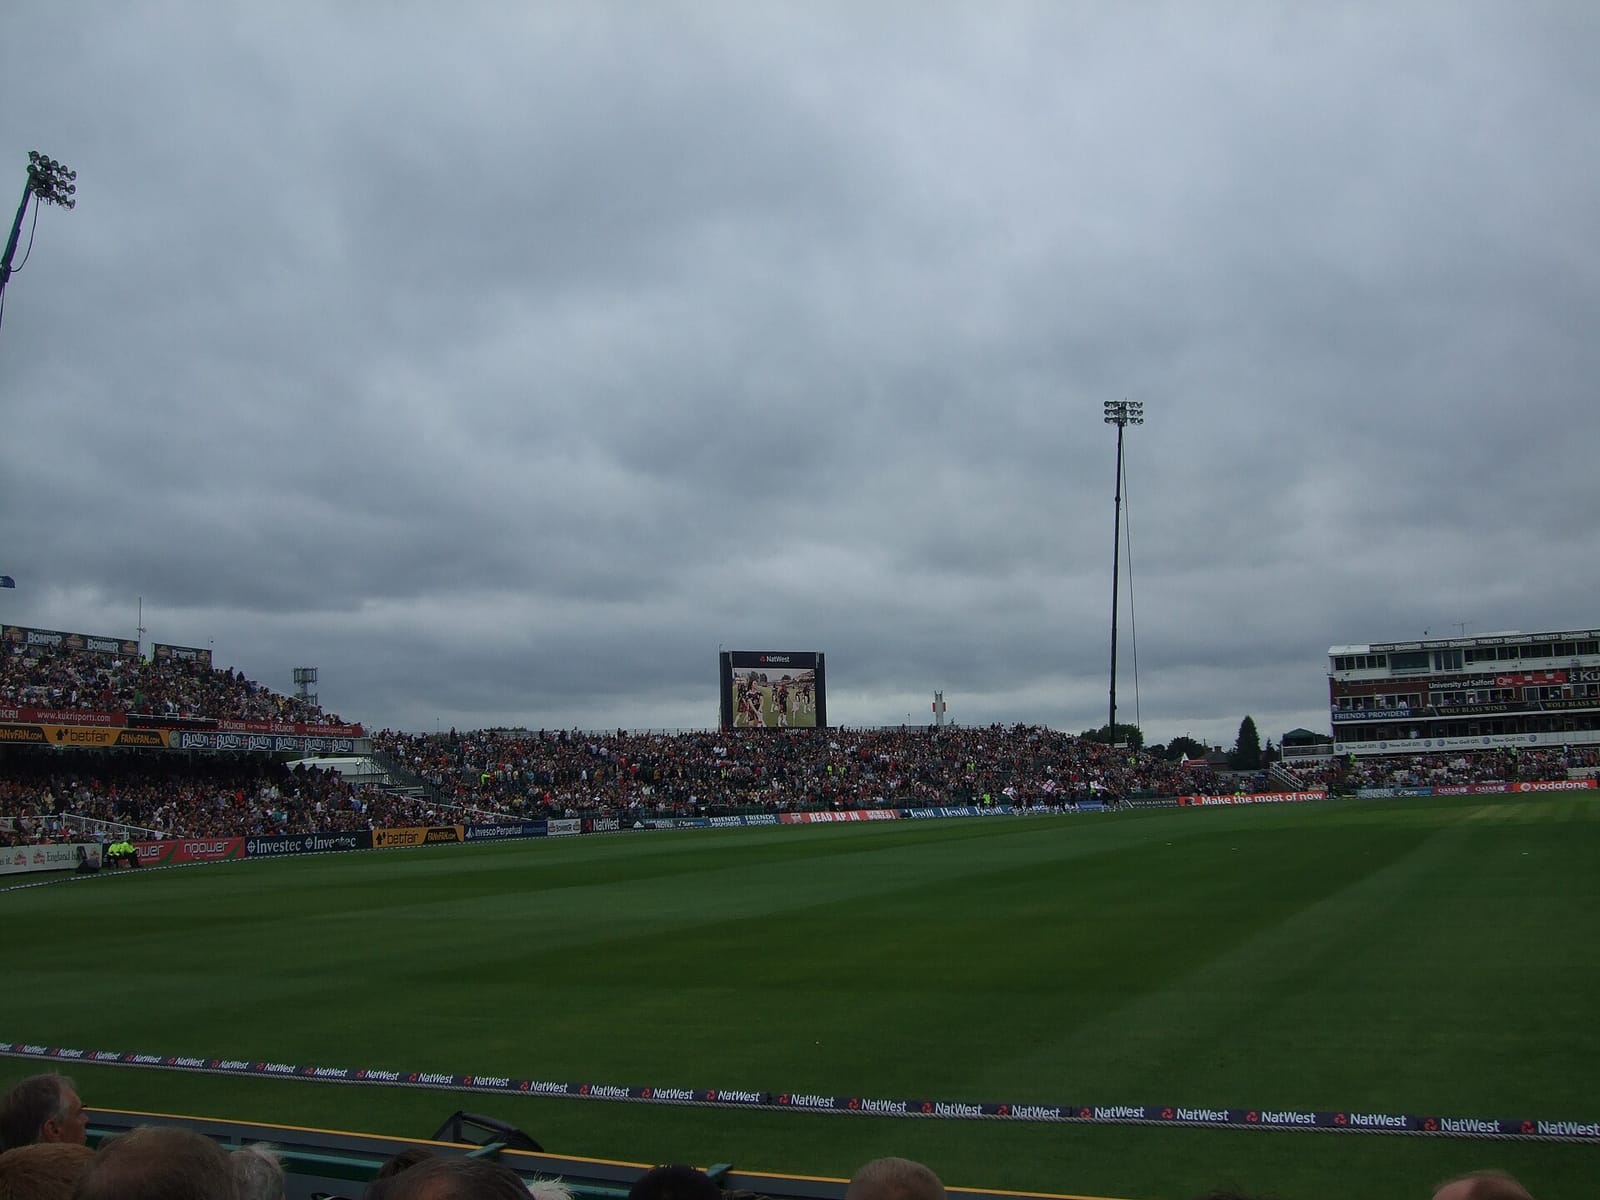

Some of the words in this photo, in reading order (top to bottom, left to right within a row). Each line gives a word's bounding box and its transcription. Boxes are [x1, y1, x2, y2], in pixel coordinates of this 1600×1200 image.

[766, 656, 790, 664] NatWest
[1470, 679, 1495, 687] Salford
[1334, 712, 1366, 720] FRIENDS
[1368, 710, 1410, 718] PROVIDENT
[71, 729, 110, 742] betfair
[1533, 779, 1589, 790] vodafone
[1202, 796, 1231, 805] Make
[1233, 794, 1252, 804] the
[1254, 793, 1284, 803] most
[1286, 792, 1297, 801] of
[1299, 791, 1323, 801] now
[709, 815, 741, 823] FRIENDS
[745, 814, 776, 822] FRIENDS
[808, 812, 833, 823] READ
[835, 812, 847, 822] KP
[475, 827, 496, 837] Invesco
[496, 825, 523, 836] Perpetual
[593, 818, 620, 832] NatWest
[387, 831, 419, 845] betfair
[184, 842, 229, 858] npower
[256, 839, 302, 854] Investec
[22, 1045, 47, 1055] NatWest
[58, 1048, 84, 1058] NatWest
[95, 1051, 121, 1061] NatWest
[133, 1054, 162, 1064] NatWest
[175, 1057, 206, 1067] NatWest
[219, 1060, 250, 1070] NatWest
[264, 1063, 297, 1073] NatWest
[314, 1066, 349, 1077] NatWest
[365, 1070, 400, 1081] NatWest
[418, 1073, 454, 1084] NatWest
[471, 1076, 510, 1087] NatWest
[530, 1080, 569, 1092] NatWest
[589, 1083, 630, 1095] NatWest
[652, 1087, 695, 1099] NatWest
[717, 1090, 761, 1102] NatWest
[790, 1094, 836, 1108] NatWest
[861, 1099, 908, 1112] NatWest
[934, 1103, 984, 1116] NatWest
[1010, 1106, 1062, 1118] NatWest
[1093, 1107, 1146, 1118] NatWest
[1176, 1109, 1230, 1121] NatWest
[1260, 1112, 1317, 1124] NatWest
[1350, 1114, 1407, 1126] NatWest
[1440, 1118, 1501, 1132] NatWest
[1537, 1121, 1600, 1135] NatWest
